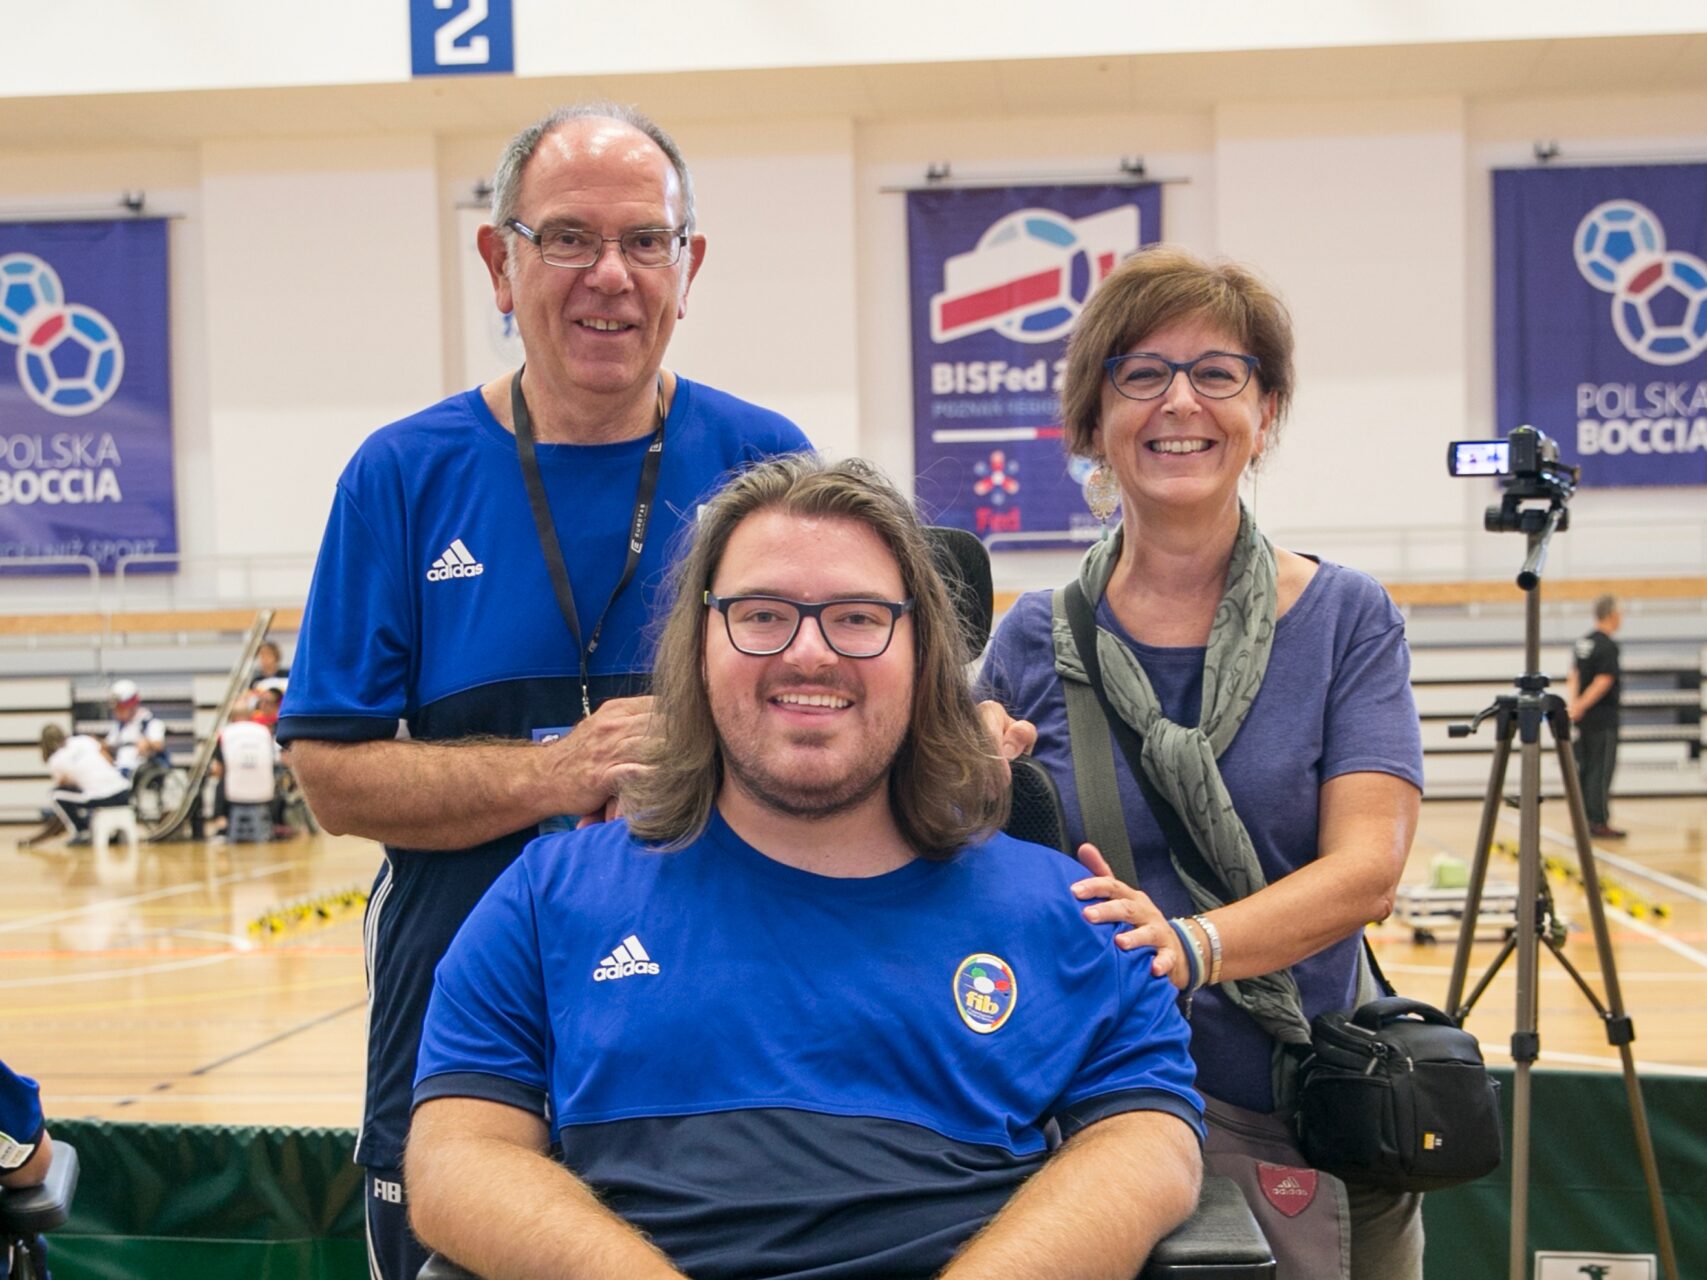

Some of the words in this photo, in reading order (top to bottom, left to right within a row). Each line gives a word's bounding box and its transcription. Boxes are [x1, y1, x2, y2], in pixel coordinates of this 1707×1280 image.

[434, 0, 489, 66] 2
[931, 360, 1047, 394] BISFed
[1577, 381, 1707, 419] POLSKA
[1577, 417, 1707, 455] BOCCIA
[426, 563, 484, 582] adidas
[593, 959, 661, 982] adidas
[966, 991, 999, 1015] fib
[374, 1177, 402, 1204] FIB
